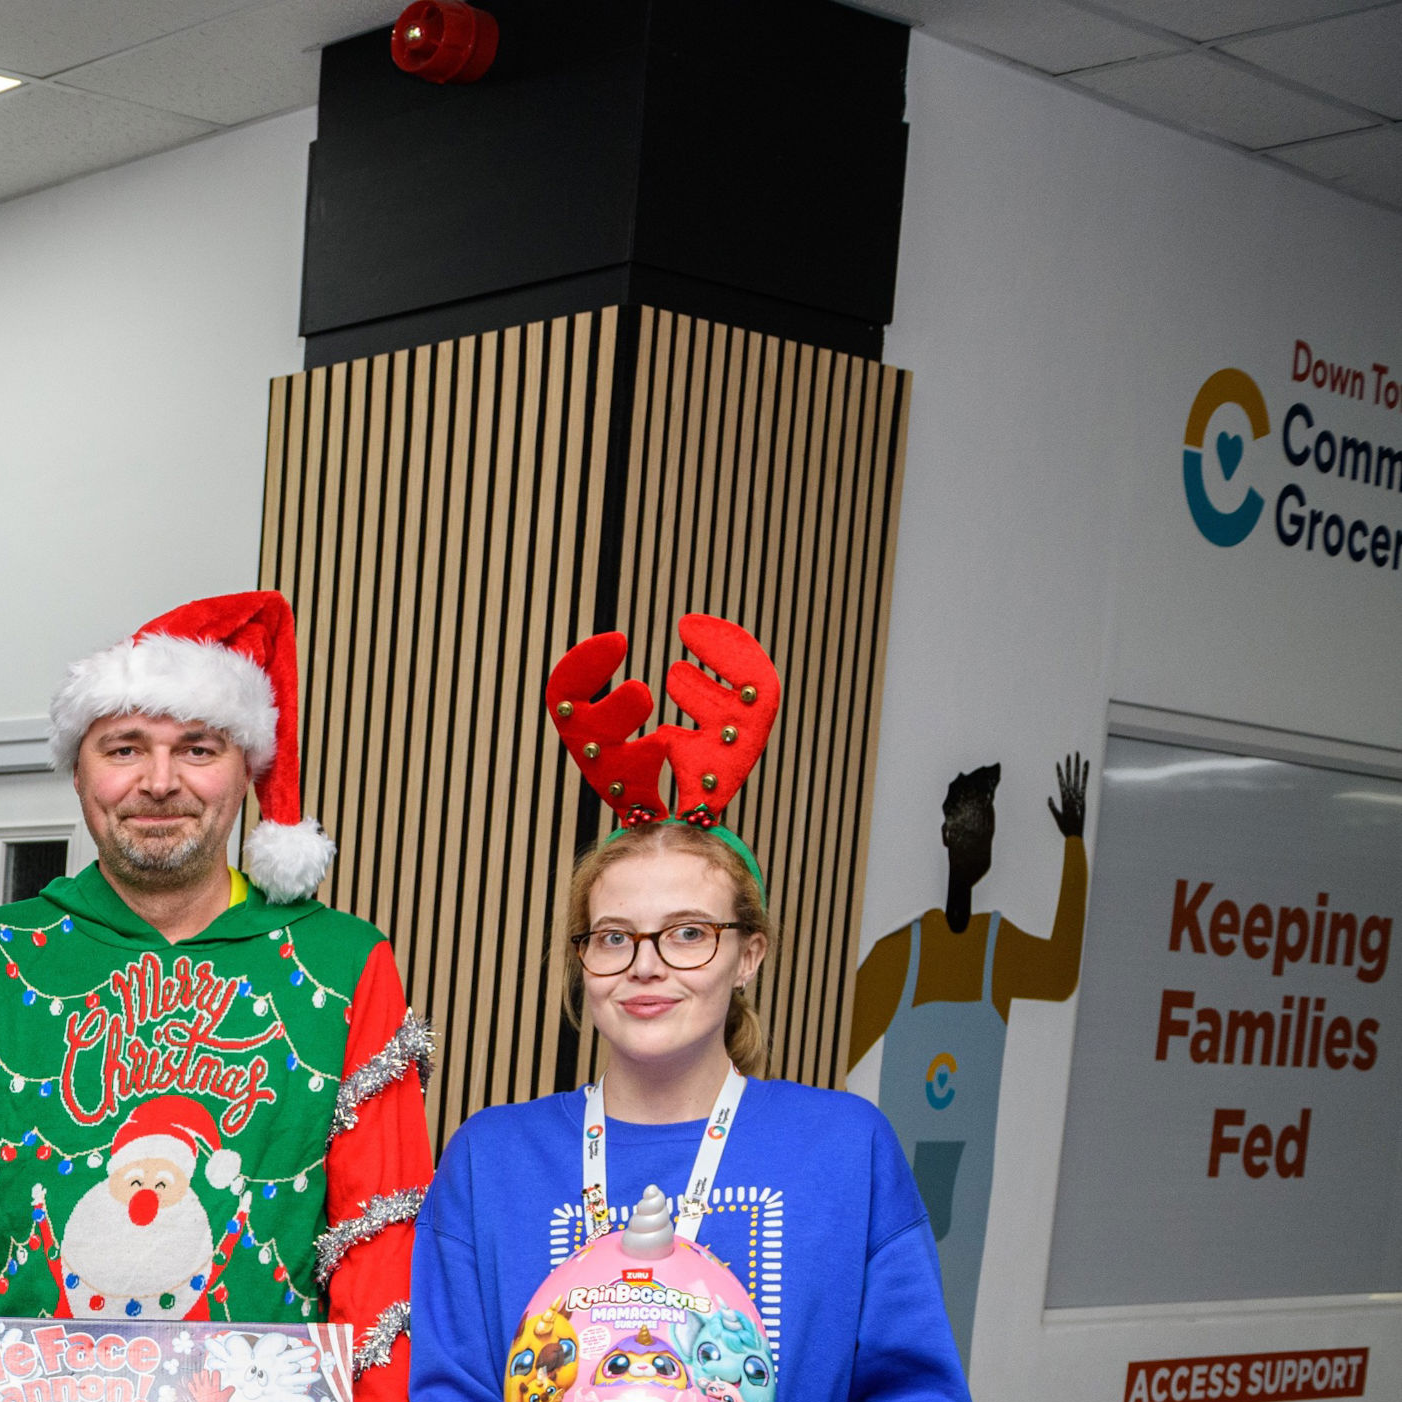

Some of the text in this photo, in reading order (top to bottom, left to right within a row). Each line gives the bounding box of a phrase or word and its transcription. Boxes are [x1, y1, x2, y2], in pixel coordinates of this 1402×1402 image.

[1292, 339, 1402, 413] Down To
[1168, 878, 1393, 983] Keeping
[110, 952, 258, 1047] Merry
[1156, 989, 1381, 1071] Families
[60, 1007, 276, 1137] Christmas
[1208, 1108, 1312, 1178] Fed
[626, 1272, 649, 1280] ZURU
[31, 1325, 161, 1375] Face
[592, 1307, 686, 1323] MAMACORN
[1247, 1355, 1364, 1396] SUPPORT
